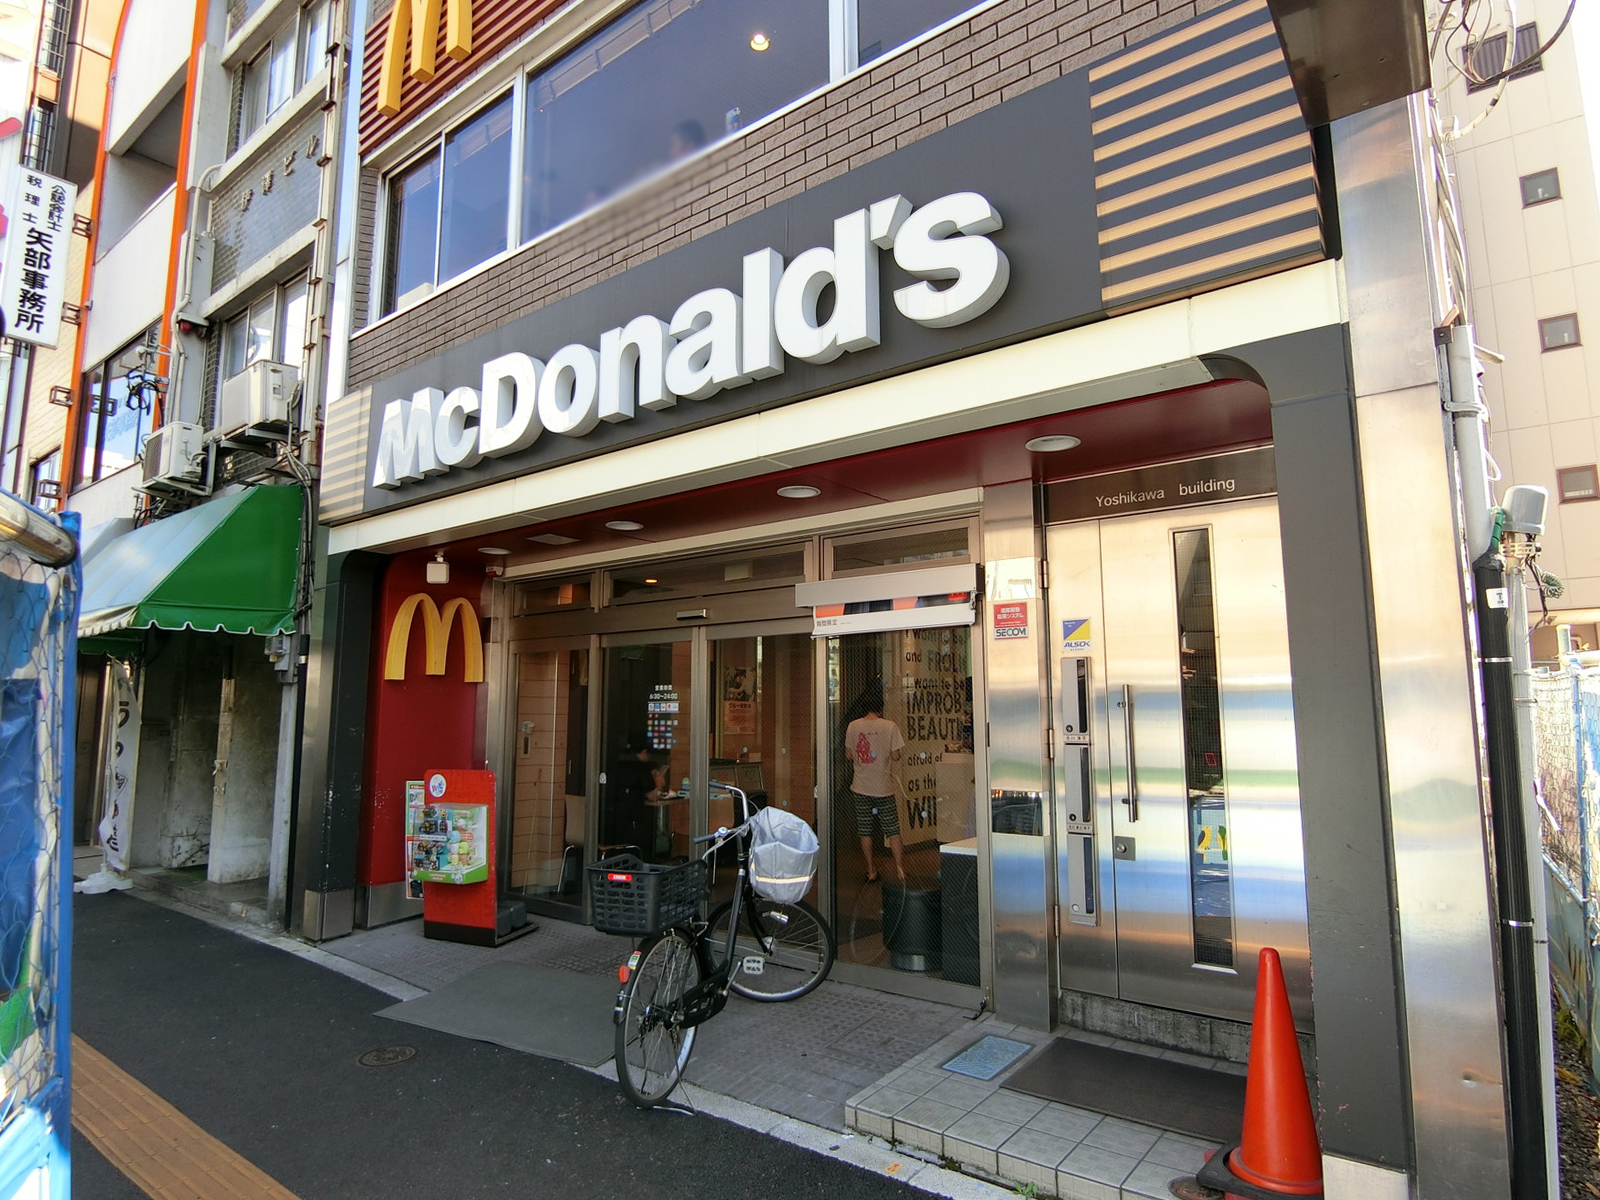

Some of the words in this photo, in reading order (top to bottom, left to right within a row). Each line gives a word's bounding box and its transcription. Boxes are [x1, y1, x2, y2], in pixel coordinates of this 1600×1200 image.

[22, 174, 43, 225] 税理士
[46, 184, 67, 233] 公認会計士
[14, 227, 54, 334] 矢部事務所
[372, 191, 1011, 491] McDonald's
[1095, 489, 1165, 508] Yoshikawa
[1179, 479, 1236, 496] building
[996, 627, 1026, 637] SECOM
[1064, 641, 1091, 649] ALSOK
